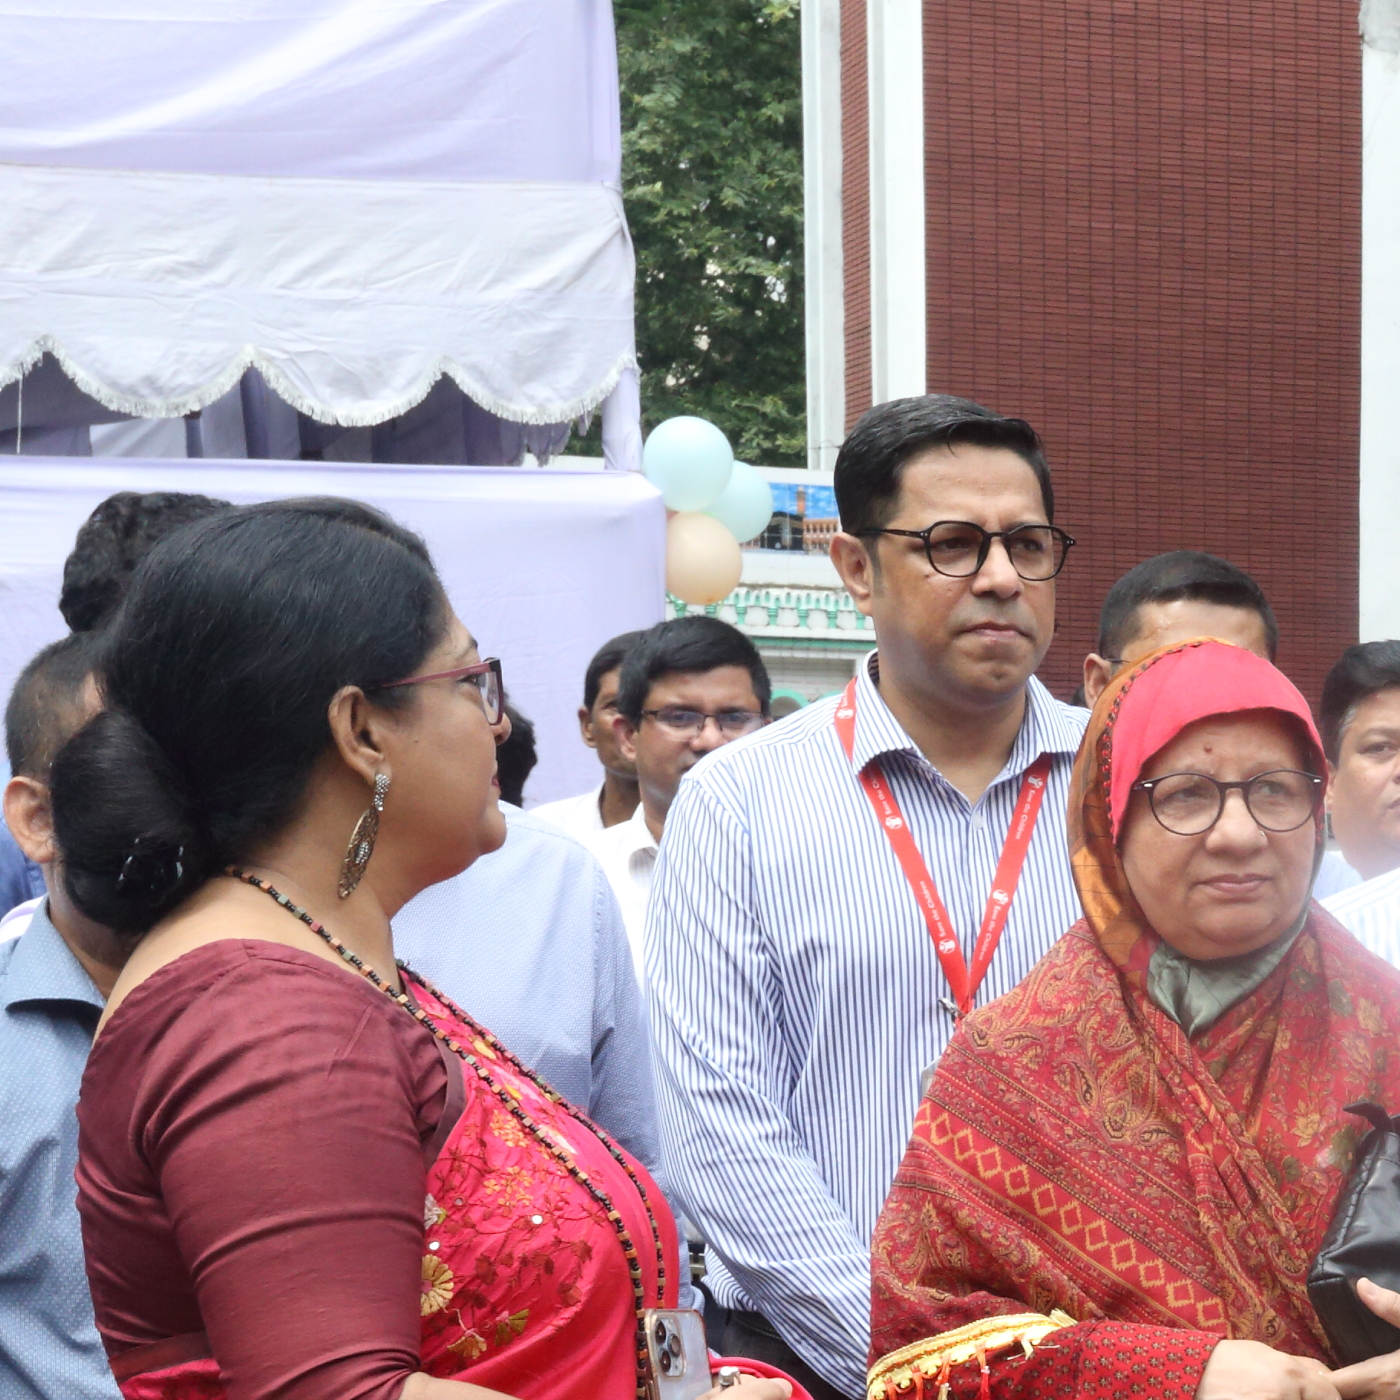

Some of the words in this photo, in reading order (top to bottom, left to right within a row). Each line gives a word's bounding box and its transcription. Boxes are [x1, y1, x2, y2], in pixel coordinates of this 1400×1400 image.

[877, 789, 886, 801] the
[1027, 790, 1036, 804] Save
[1023, 804, 1031, 814] the
[1015, 814, 1028, 840] Children
[920, 880, 935, 909] Children
[930, 907, 941, 923] the
[991, 905, 1002, 921] Save
[935, 921, 946, 938] Save
[987, 919, 997, 933] the
[978, 932, 992, 961] Children
